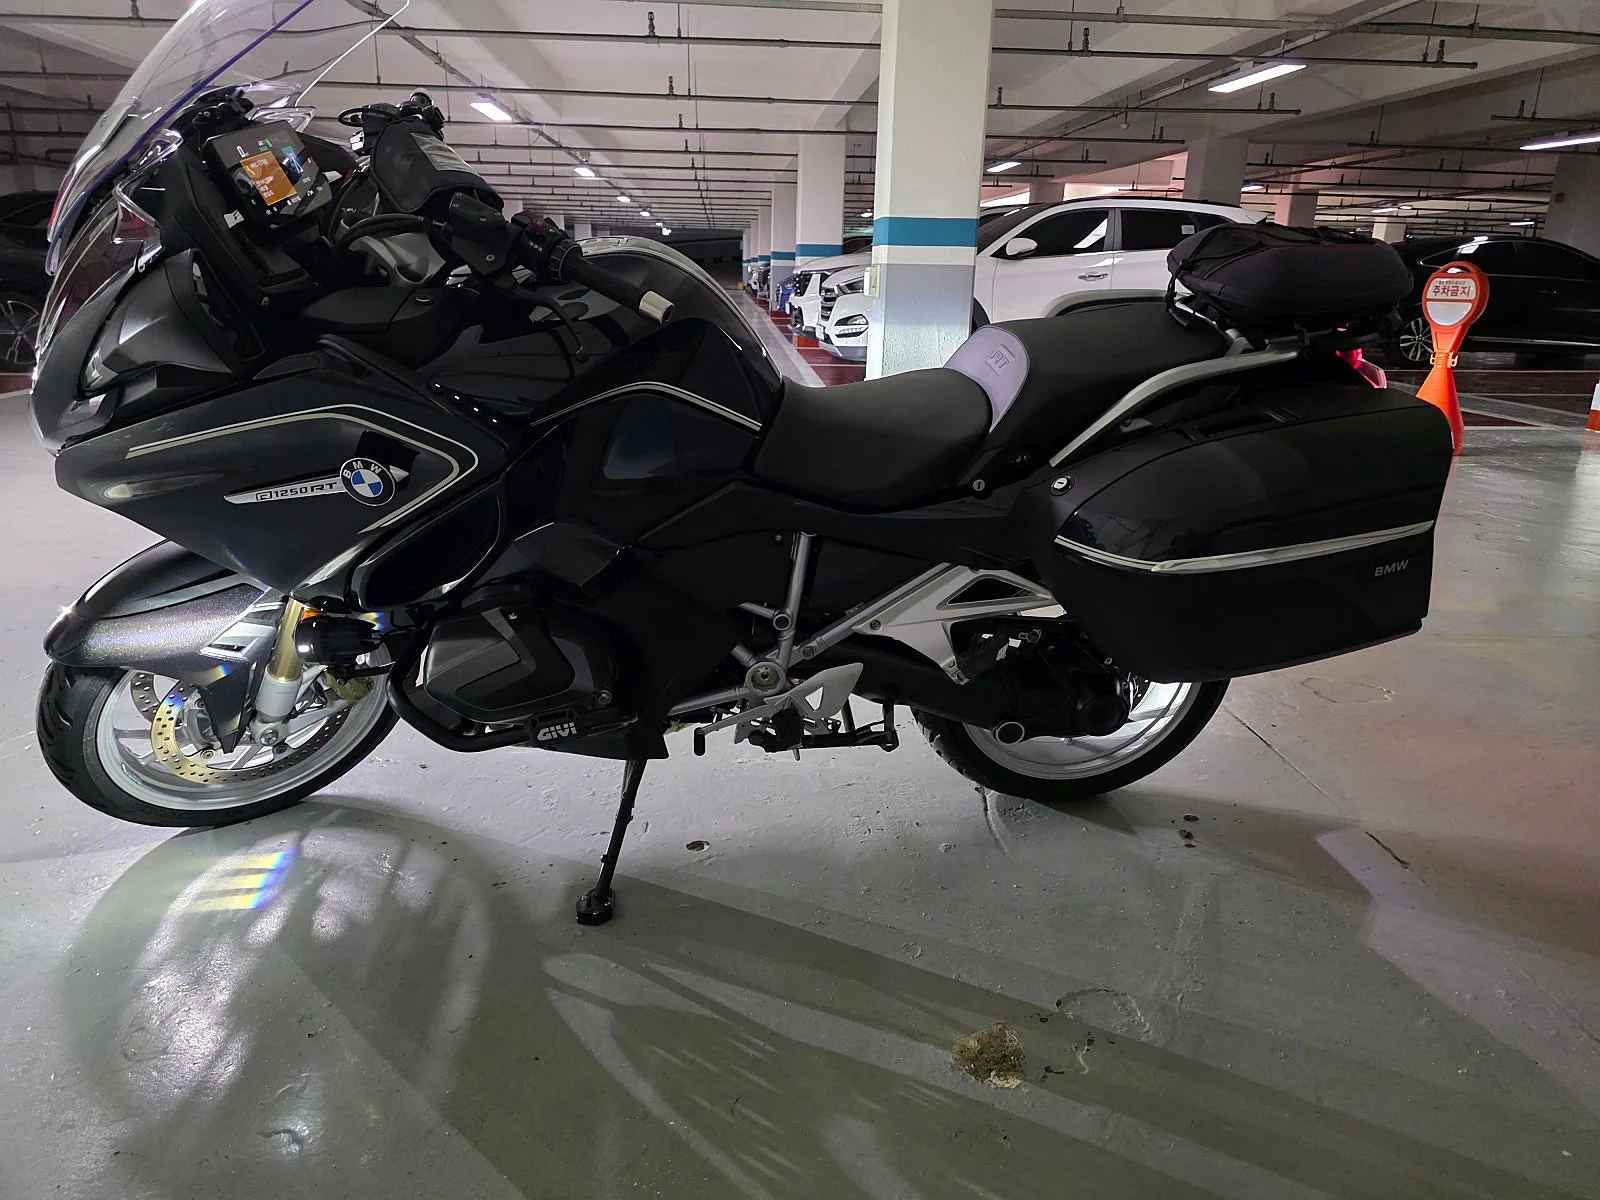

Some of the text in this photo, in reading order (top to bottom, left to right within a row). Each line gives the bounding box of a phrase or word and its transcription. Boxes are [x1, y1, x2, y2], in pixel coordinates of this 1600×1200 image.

[1432, 285, 1471, 297] 주차금지
[342, 460, 382, 479] BMW
[1374, 559, 1409, 577] BMW
